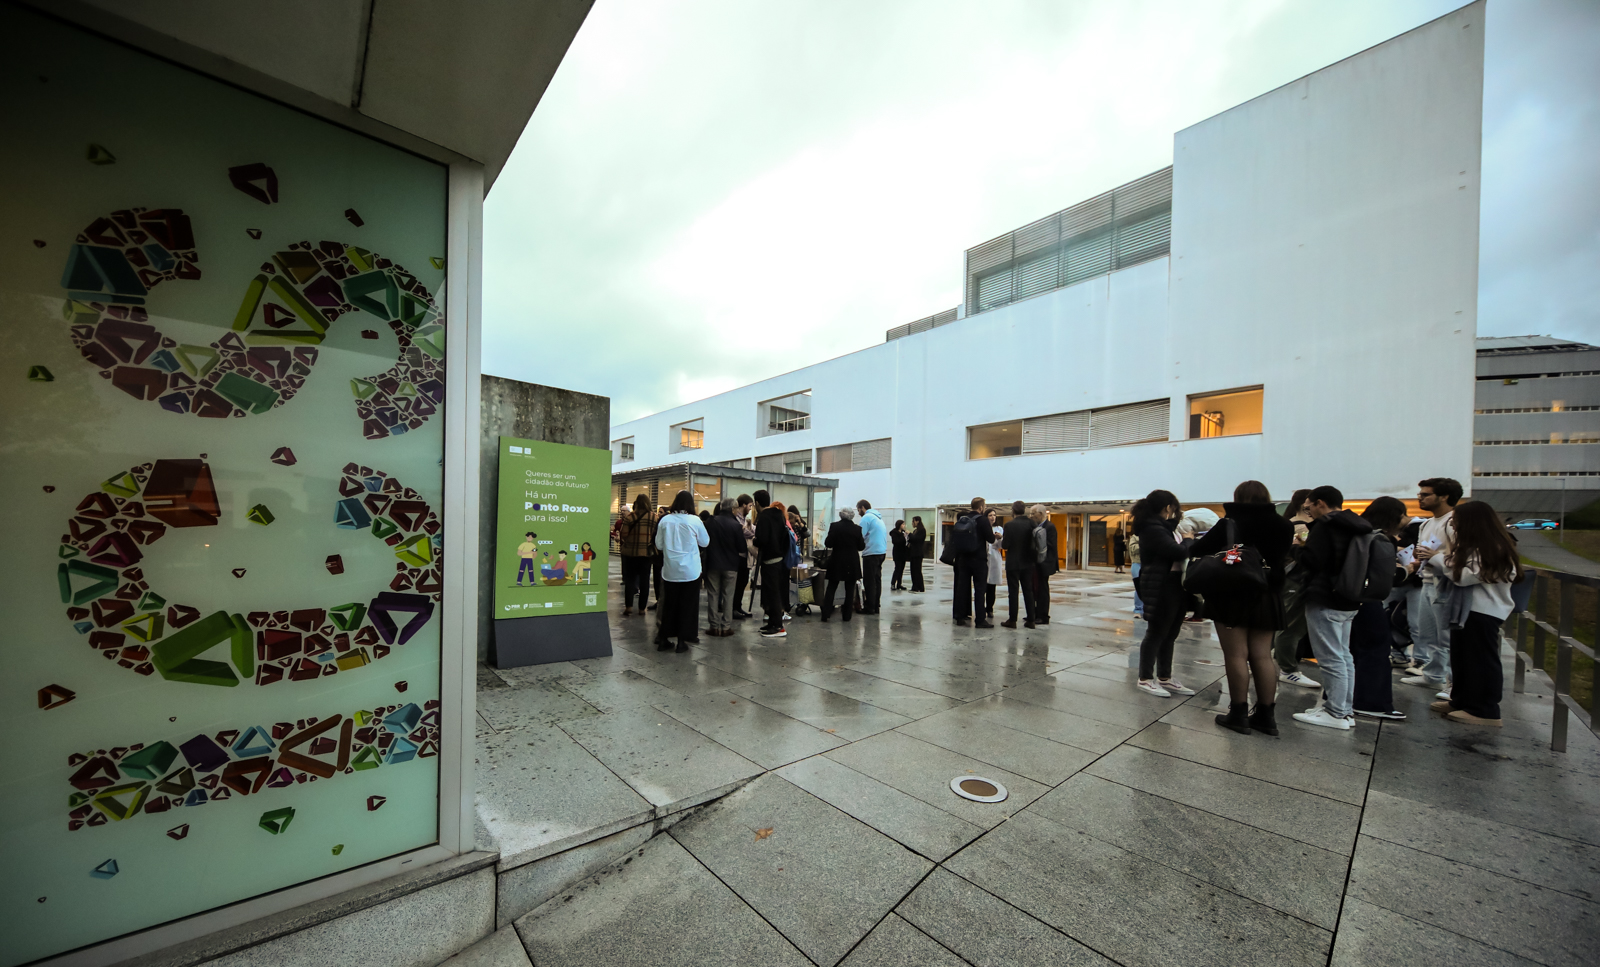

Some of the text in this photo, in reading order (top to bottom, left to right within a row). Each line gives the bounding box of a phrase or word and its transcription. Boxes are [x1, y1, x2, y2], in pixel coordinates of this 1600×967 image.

[525, 469, 552, 478] Queres
[525, 478, 554, 486] cidadão
[565, 481, 589, 489] futuro?
[525, 490, 538, 498] Há
[562, 504, 589, 513] Roxo
[524, 514, 568, 523] para isso!
